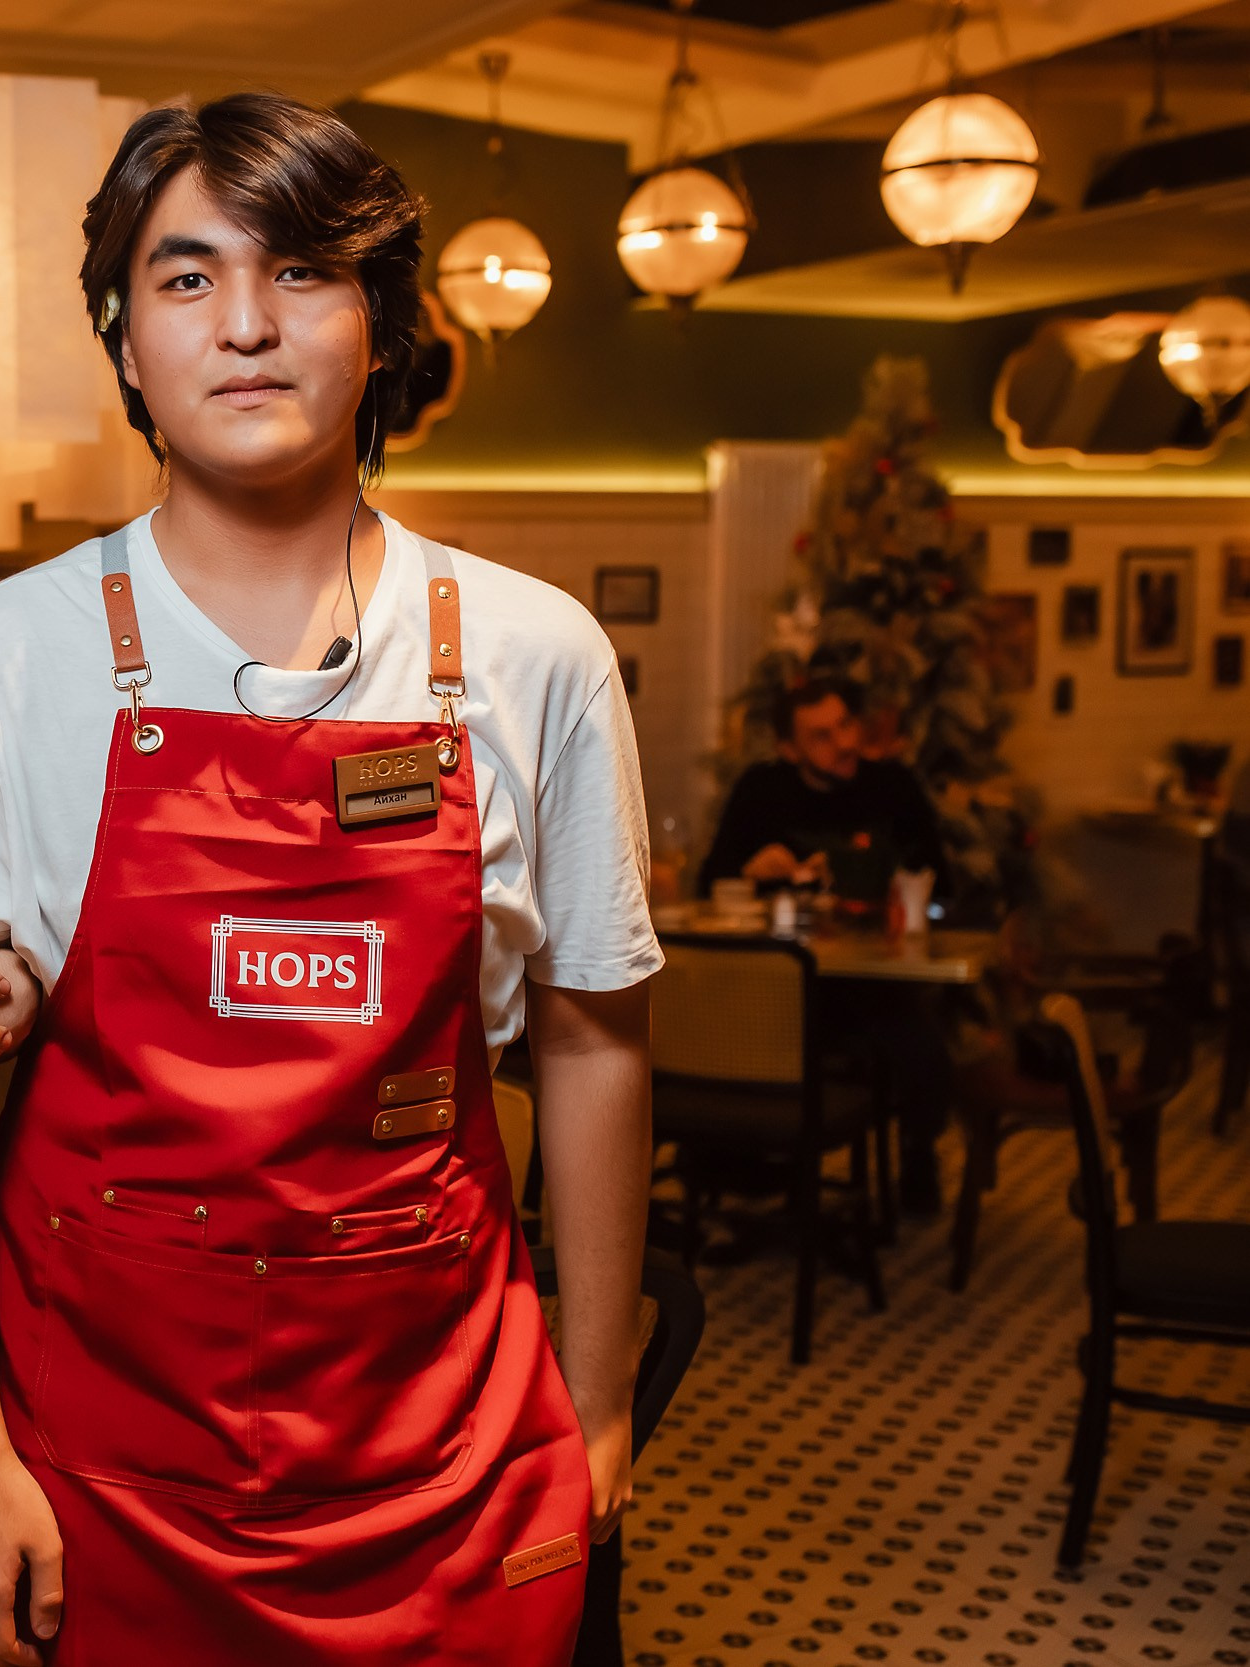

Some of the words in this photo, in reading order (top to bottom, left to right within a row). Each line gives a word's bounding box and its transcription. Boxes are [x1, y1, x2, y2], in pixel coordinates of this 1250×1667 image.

[359, 754, 418, 780] HOPS
[374, 793, 407, 805] Айхан
[237, 950, 357, 990] HOPS
